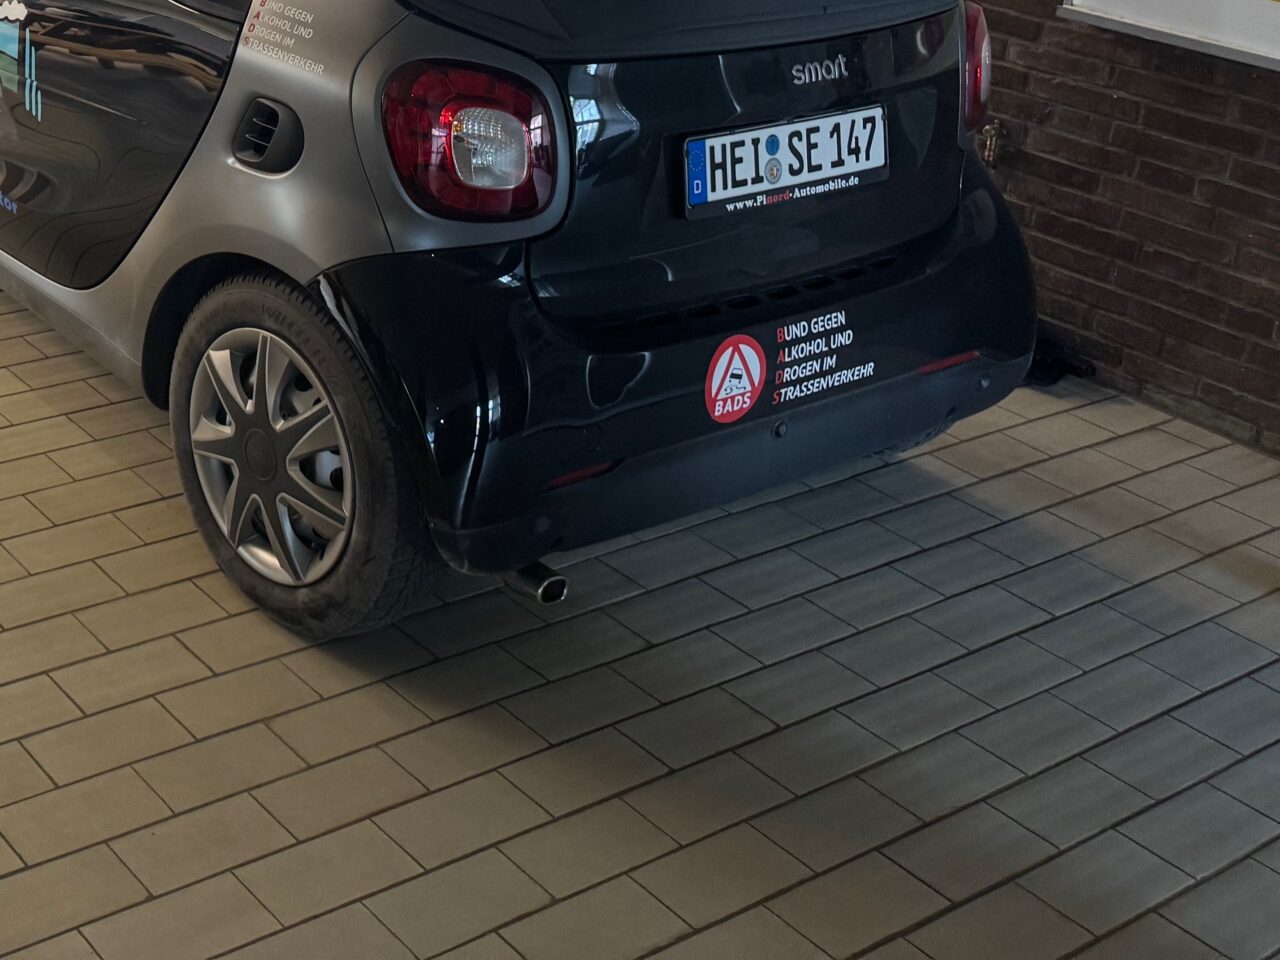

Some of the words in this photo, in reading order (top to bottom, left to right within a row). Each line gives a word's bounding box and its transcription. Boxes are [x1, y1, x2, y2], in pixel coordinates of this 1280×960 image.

[254, 11, 293, 33] ALKOHOL
[293, 25, 314, 39] UND
[284, 6, 314, 23] GEGEN
[248, 24, 283, 43] DROGEN
[282, 37, 295, 48] IM
[242, 36, 325, 75] STRASSENVERKEHR
[791, 53, 848, 85] smart
[709, 137, 764, 193] HEI
[787, 125, 823, 177] SE
[829, 114, 877, 169] 147
[694, 179, 702, 194] D
[776, 320, 809, 343] BUND
[810, 310, 846, 334] GEGEN
[776, 338, 829, 365] ALKOHOL
[830, 329, 854, 348] UND
[772, 361, 876, 405] STRASSENVERKEHR
[775, 361, 821, 385] DROGEN
[822, 354, 837, 370] IM
[714, 391, 752, 417] BADS
